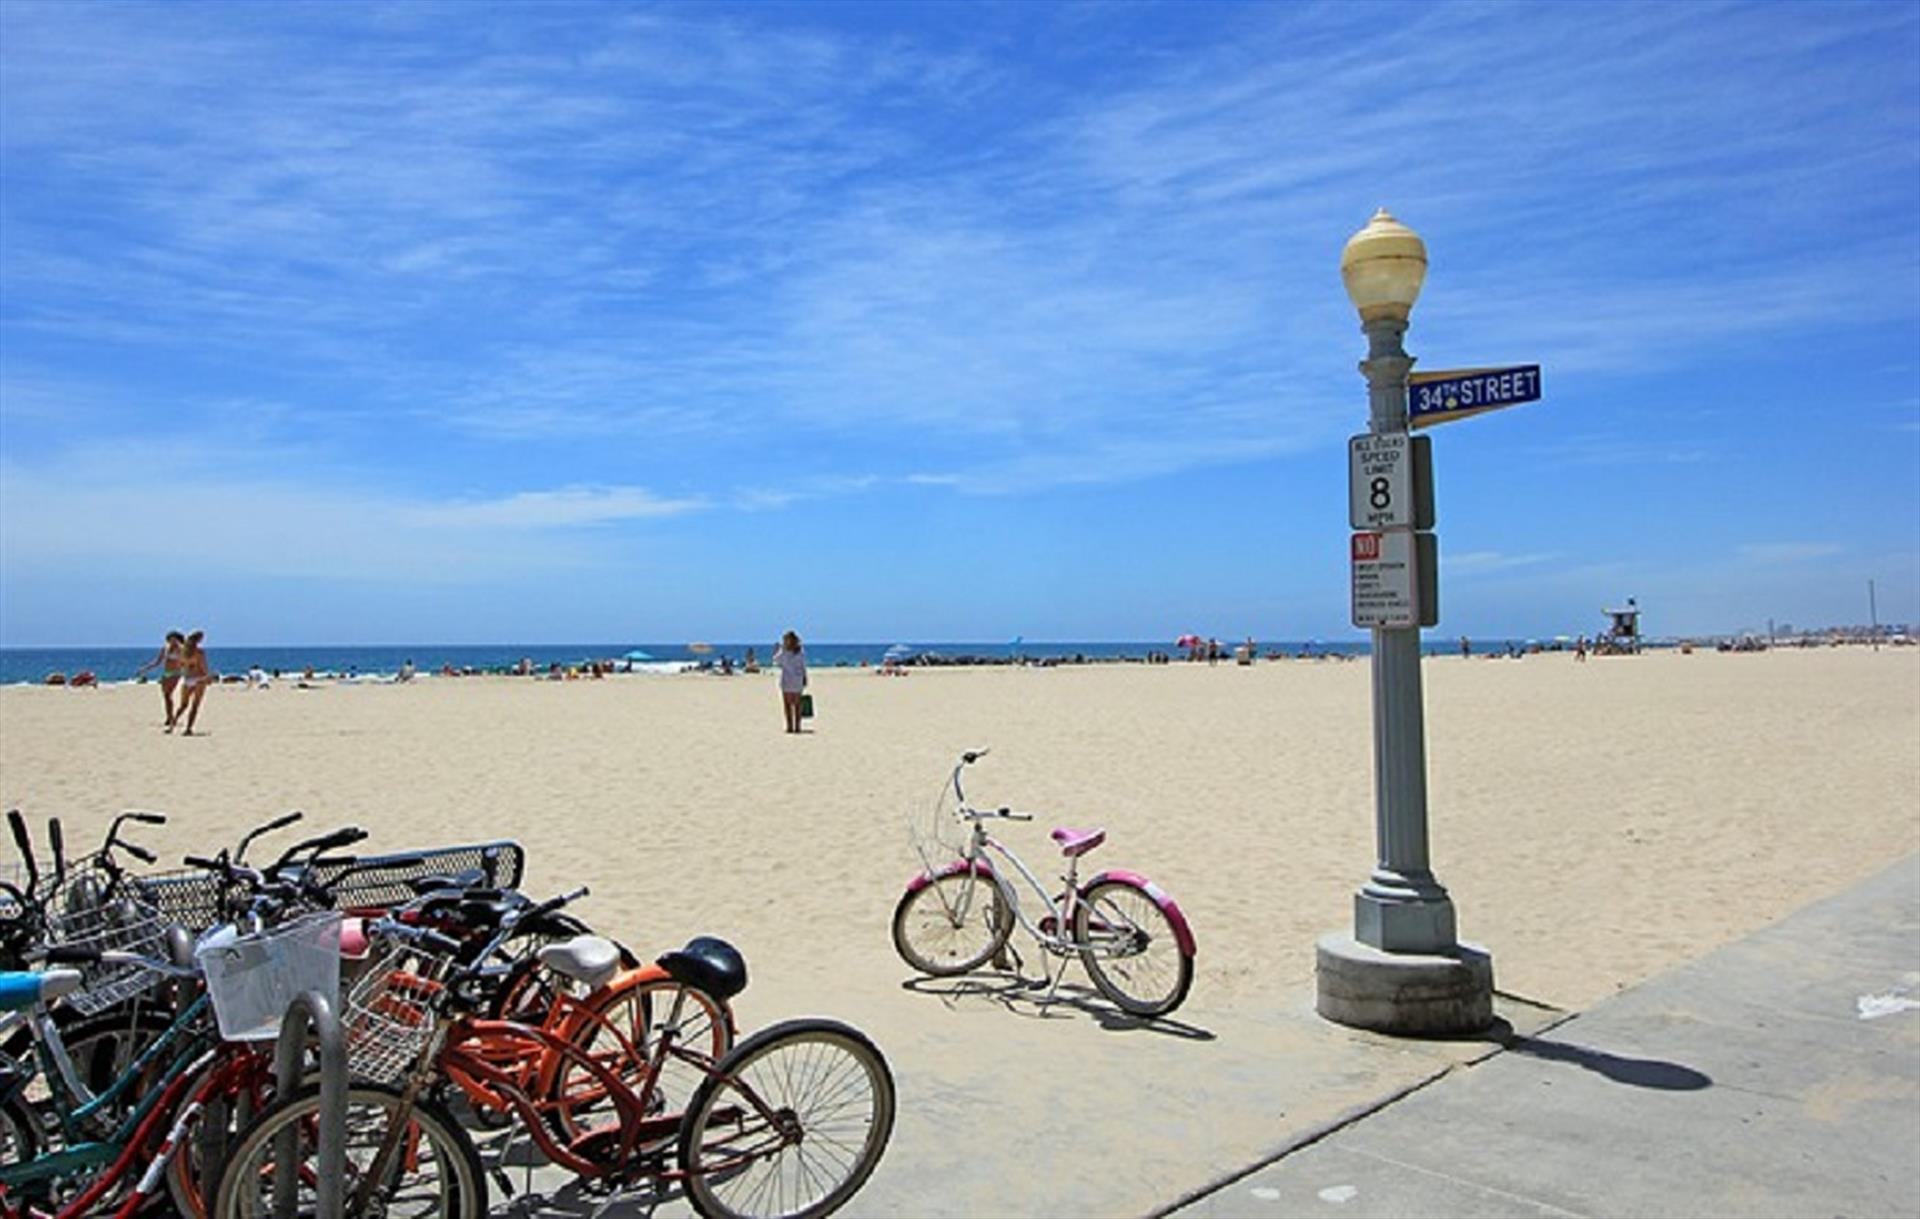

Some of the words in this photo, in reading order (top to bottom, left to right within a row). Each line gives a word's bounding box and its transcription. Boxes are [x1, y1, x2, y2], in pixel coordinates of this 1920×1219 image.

[1420, 382, 1459, 410] 34TH
[1460, 370, 1537, 404] STREET
[1361, 450, 1400, 463] SPEED
[1364, 463, 1394, 475] LIMIT
[1370, 477, 1391, 509] 8
[1355, 534, 1376, 555] NO
